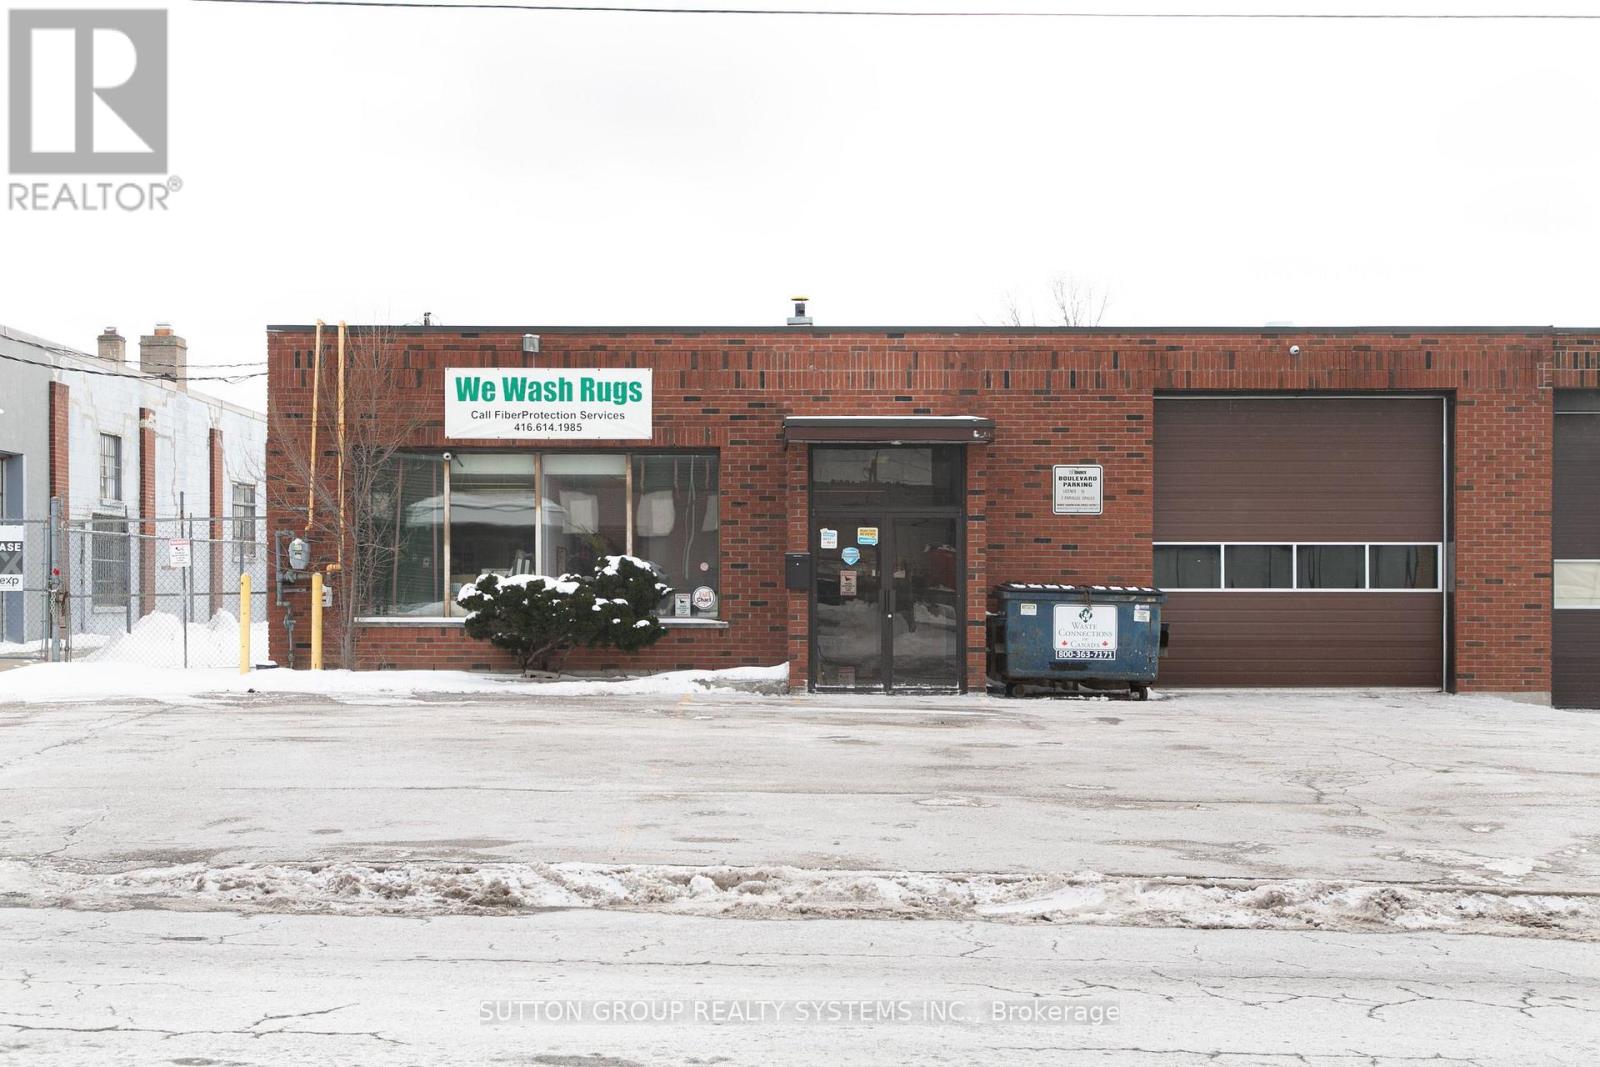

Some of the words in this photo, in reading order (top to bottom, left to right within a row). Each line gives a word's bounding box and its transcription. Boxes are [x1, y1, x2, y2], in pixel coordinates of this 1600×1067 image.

[455, 377, 496, 402] We
[502, 377, 573, 402] Wash
[580, 377, 643, 405] Rugs
[471, 410, 491, 420] Call
[494, 410, 576, 420] FiberProtection
[580, 410, 625, 420] Services
[514, 423, 582, 432] 416.614.1985
[0, 542, 21, 552] ASE
[1071, 621, 1097, 629] WASTE
[1058, 629, 1113, 637] CONNECTIONS
[1070, 640, 1101, 648] CANADA
